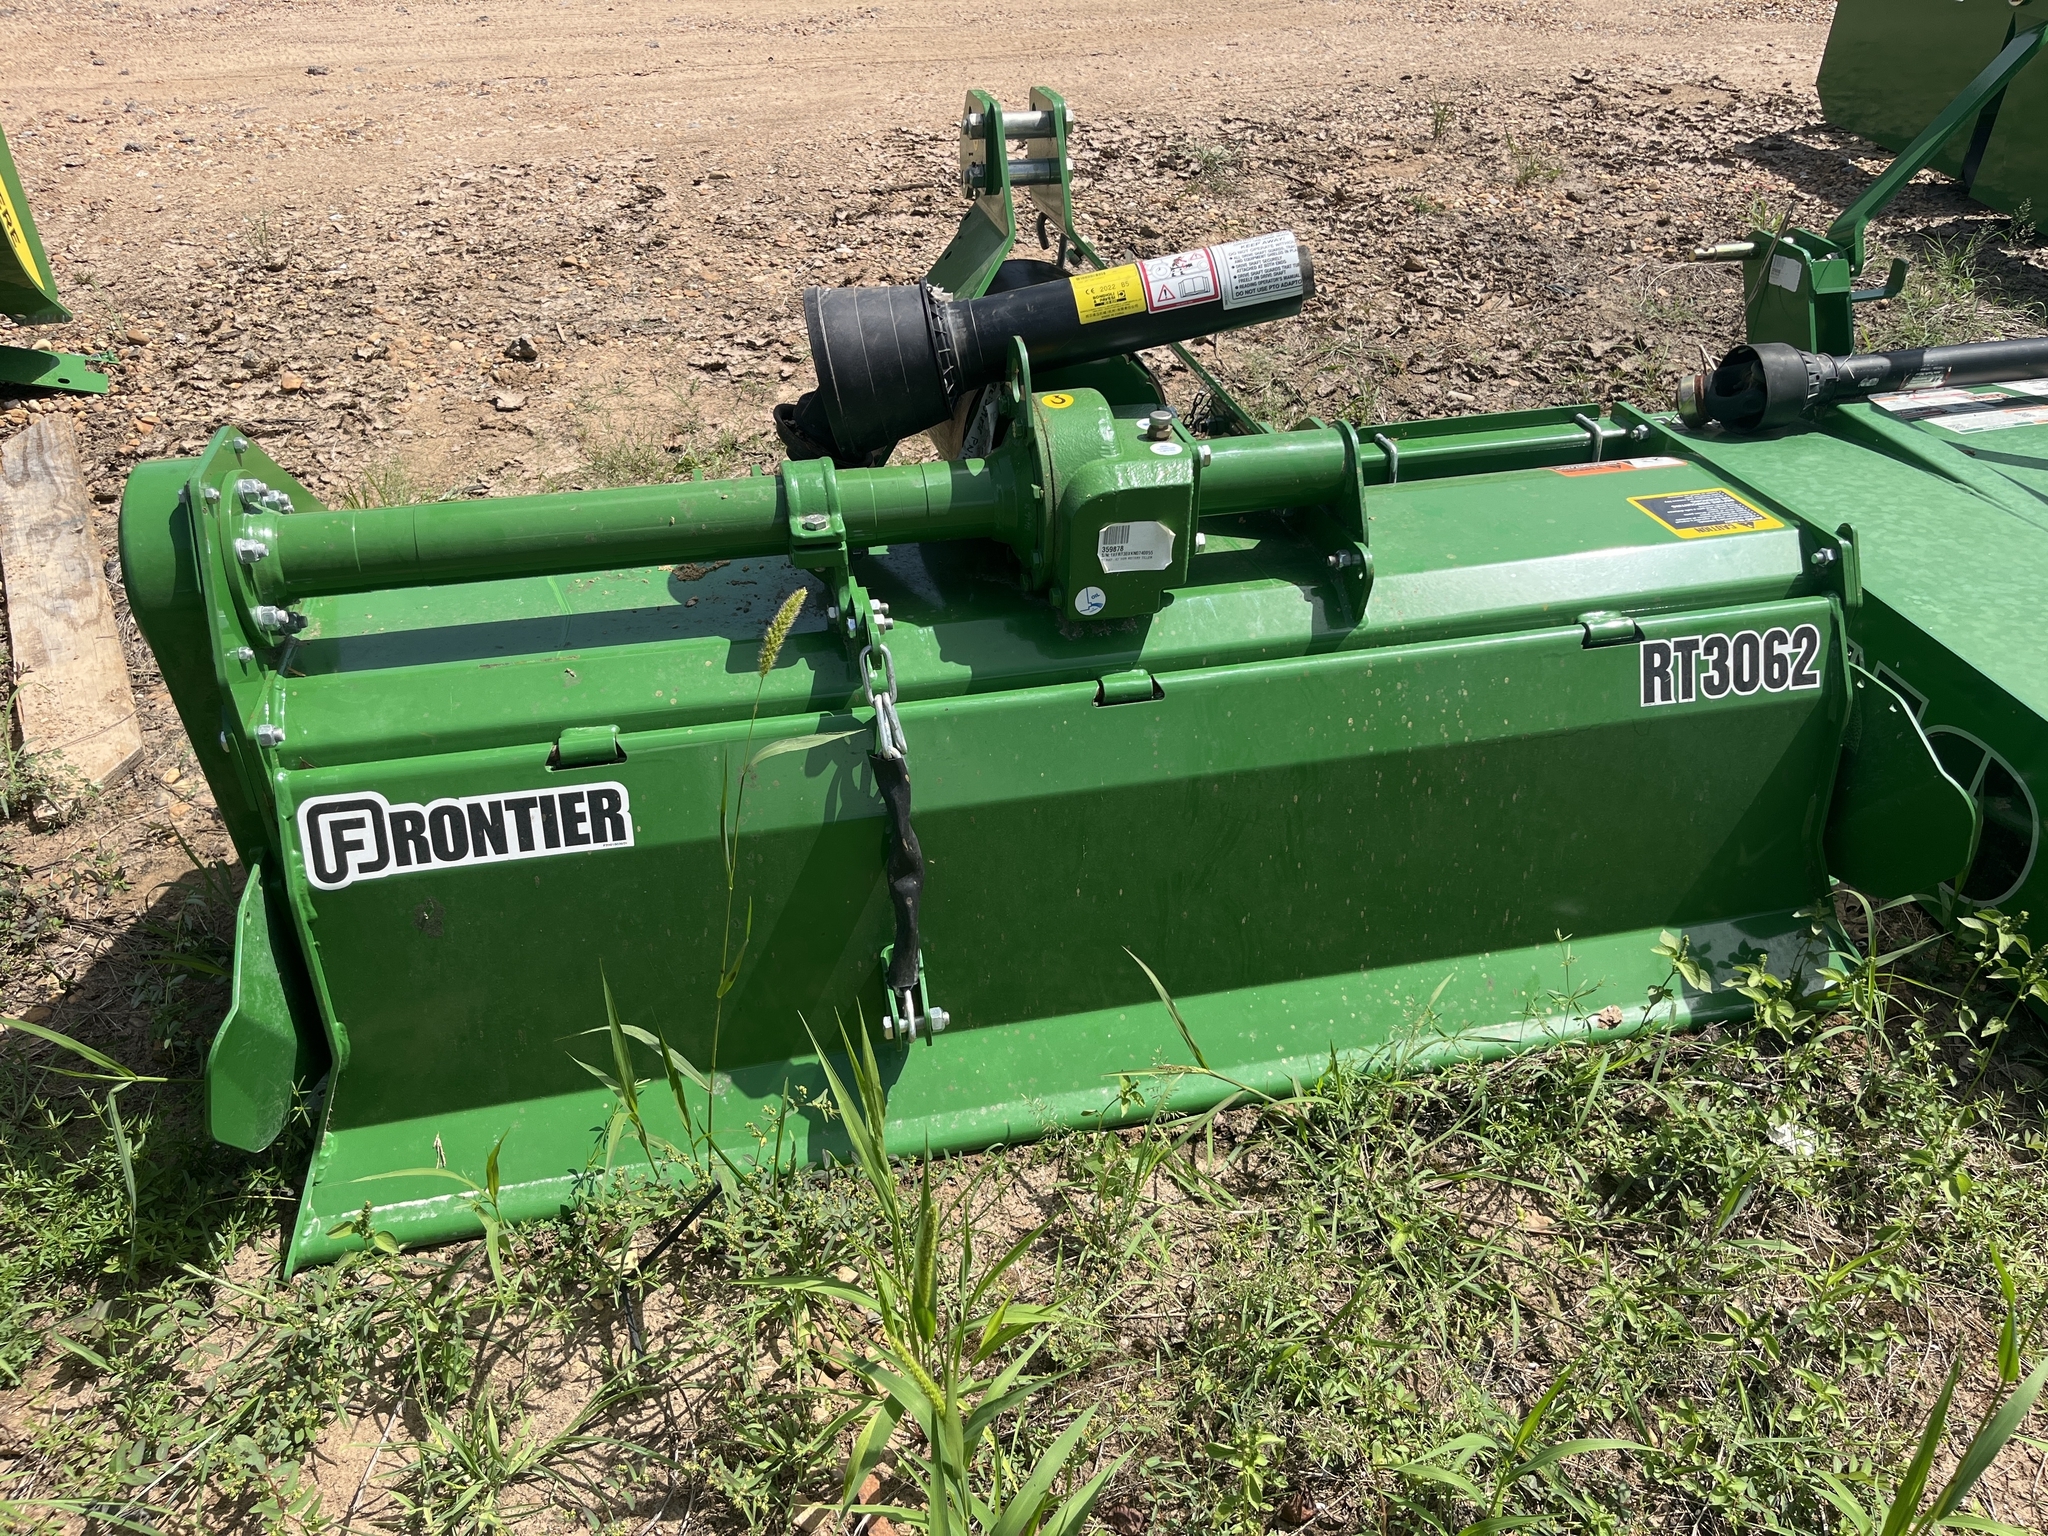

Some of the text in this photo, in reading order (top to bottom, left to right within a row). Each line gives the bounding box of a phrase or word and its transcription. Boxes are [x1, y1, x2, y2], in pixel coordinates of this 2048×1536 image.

[1100, 284, 1116, 292] 2022
[1694, 524, 1737, 534] CAUTION
[1101, 545, 1124, 553] 359878
[1642, 625, 1819, 706] RT3062
[306, 787, 627, 884] FRONTIER
